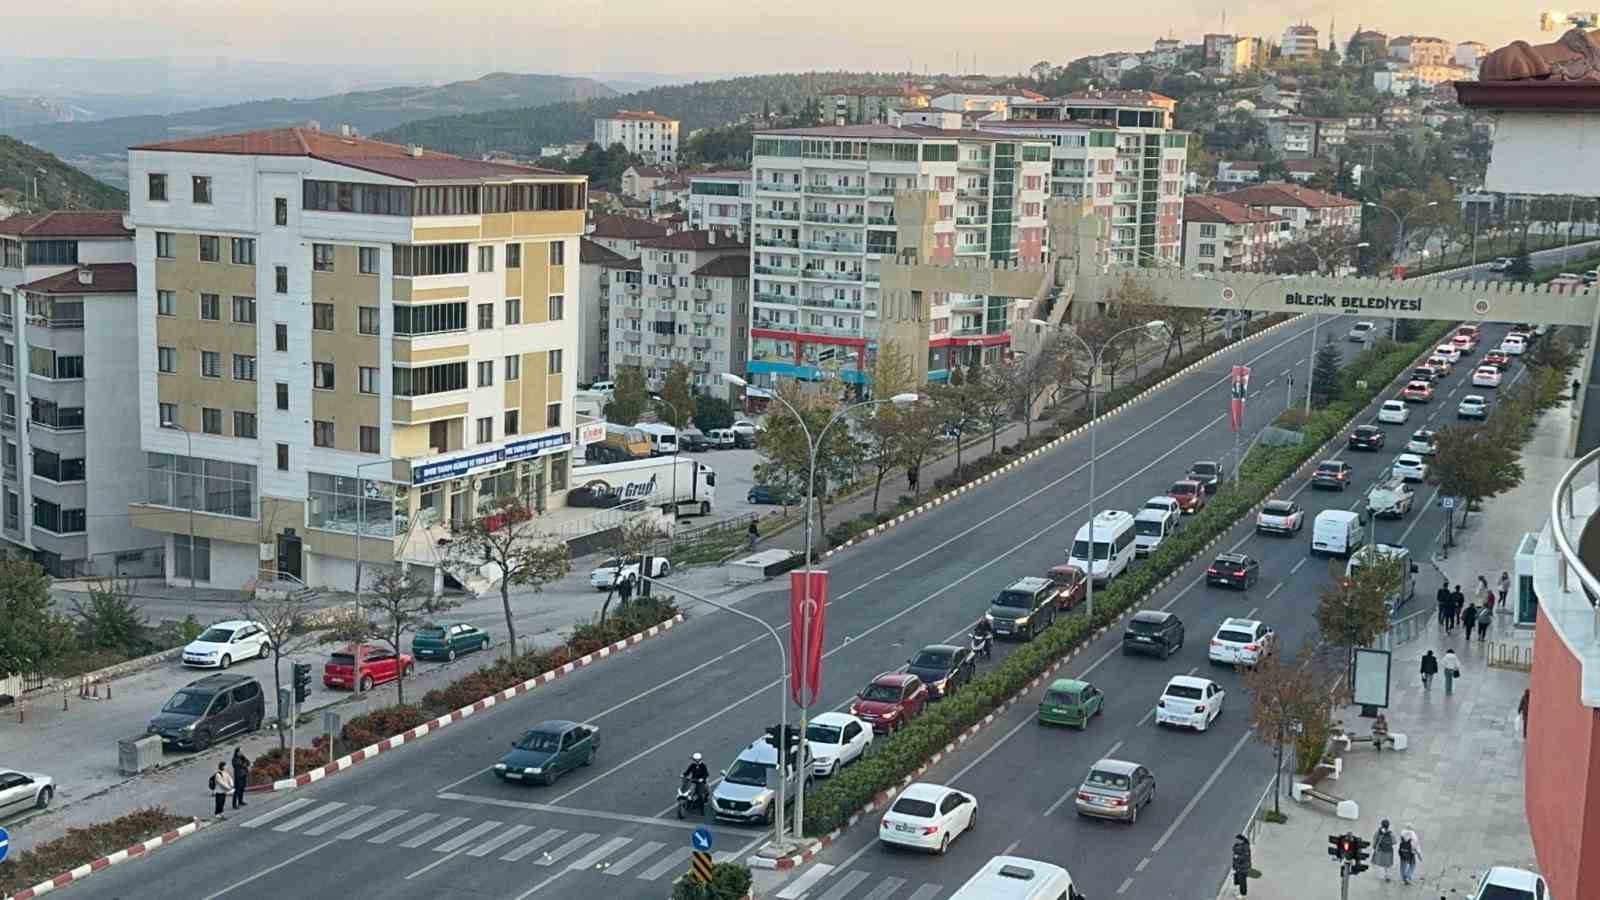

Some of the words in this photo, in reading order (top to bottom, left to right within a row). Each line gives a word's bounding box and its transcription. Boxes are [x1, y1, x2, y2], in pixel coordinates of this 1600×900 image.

[1286, 292, 1336, 307] BİLECİK
[1341, 296, 1422, 311] BELEDİYESİ
[625, 481, 654, 497] Grup
